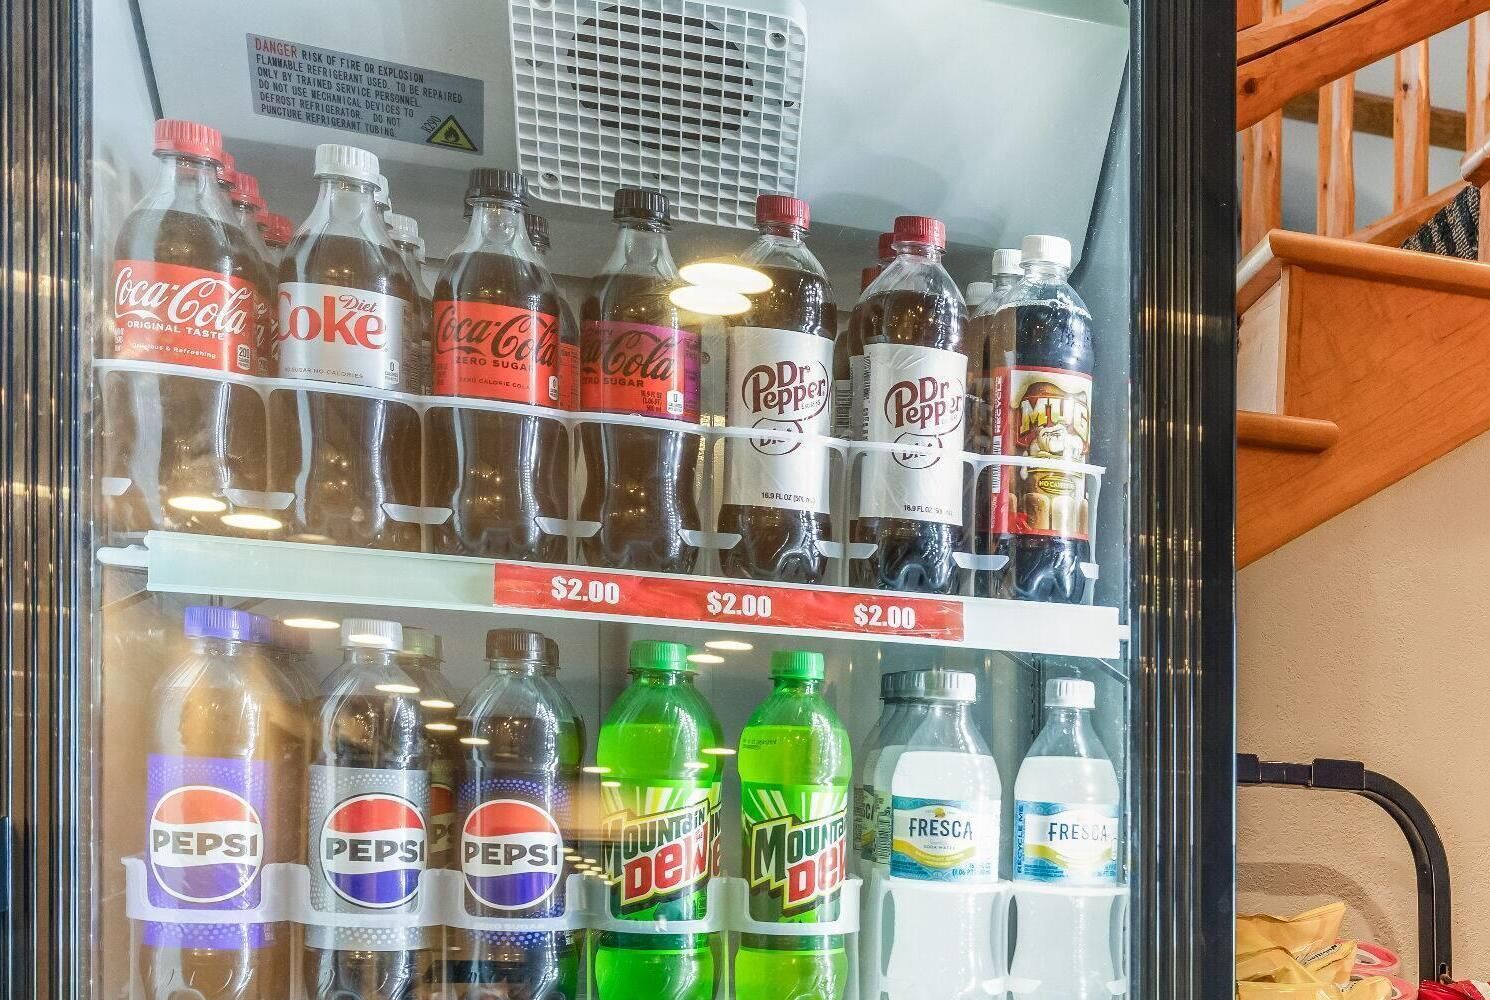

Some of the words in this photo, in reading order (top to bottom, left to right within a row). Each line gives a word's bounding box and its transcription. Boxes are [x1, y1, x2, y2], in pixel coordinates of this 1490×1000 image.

[255, 38, 297, 58] DANGER
[302, 51, 323, 63] RISK
[327, 56, 337, 66] OF
[340, 58, 361, 71] FIRE
[364, 63, 375, 73] OR
[378, 66, 424, 83] EXPLOSION
[256, 54, 302, 72] FLAMMABLE
[307, 65, 363, 84] REFRIGERANT
[396, 83, 406, 91] TO
[409, 85, 419, 95] BE
[422, 88, 463, 103] REPAIRED
[258, 67, 278, 79] ONLY
[283, 73, 292, 82] BY
[297, 75, 332, 90] TRAINED
[336, 84, 371, 98] SERVICE
[259, 79, 269, 89] DO
[273, 82, 287, 93] NOT
[293, 85, 307, 96] USE
[311, 89, 361, 107] MECHANICAL
[365, 101, 400, 115] DEVICES
[404, 108, 413, 118] TO
[260, 92, 295, 107] DEFROST
[300, 100, 363, 119] REFRIGERATOR.
[373, 113, 383, 123] DO
[386, 116, 401, 127] NOT
[261, 105, 301, 120] PUNCTURE
[306, 112, 360, 132] REFRIGERANT
[339, 294, 376, 312] Diet
[128, 320, 180, 334] ORIGINAL
[186, 327, 224, 340] TASTE
[603, 378, 644, 388] SUGAR
[776, 361, 810, 388] Dr
[742, 365, 826, 414] Pepper
[919, 377, 950, 403] Dr
[885, 380, 962, 429] Pepper
[551, 576, 619, 604] $2.00
[707, 591, 772, 618] $2.00
[853, 603, 916, 630] $2.00
[1017, 805, 1024, 820] ME
[153, 829, 258, 856] PEPSI
[910, 818, 973, 840] FRESCA
[1048, 822, 1107, 841] FRESCA
[326, 838, 425, 863] PEPSI
[465, 842, 558, 866] PEPSI
[1016, 824, 1024, 874] RECYCLE
